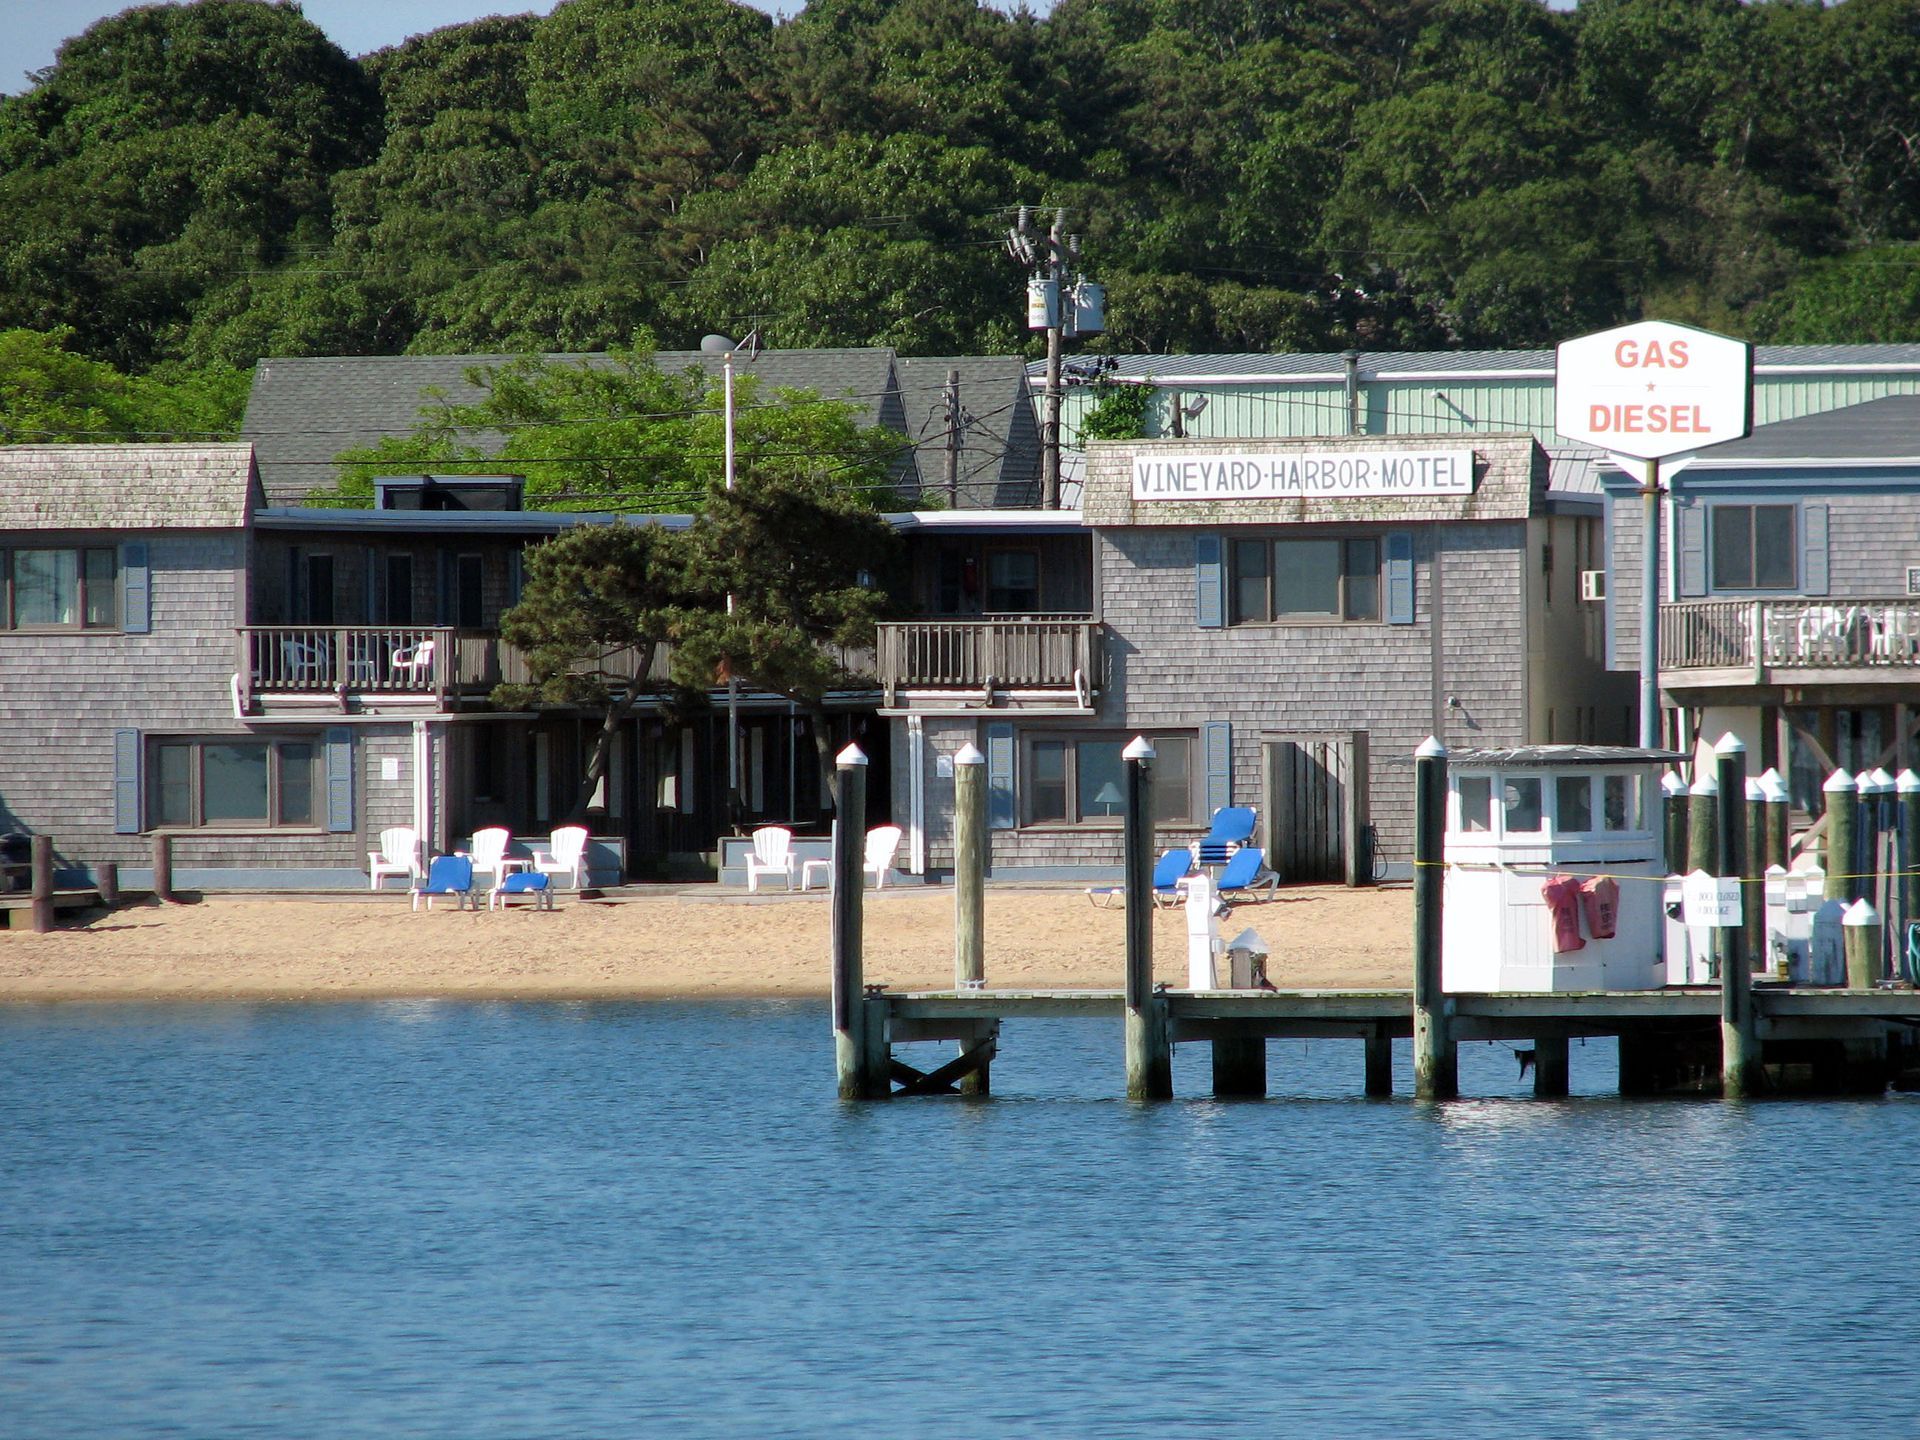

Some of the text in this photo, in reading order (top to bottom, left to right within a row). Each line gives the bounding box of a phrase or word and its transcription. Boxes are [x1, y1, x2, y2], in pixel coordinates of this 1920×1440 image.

[1614, 340, 1689, 369] GAS
[1588, 404, 1711, 433] DIESEL
[1138, 457, 1466, 493] VINEYARD HARBOR MOTEL
